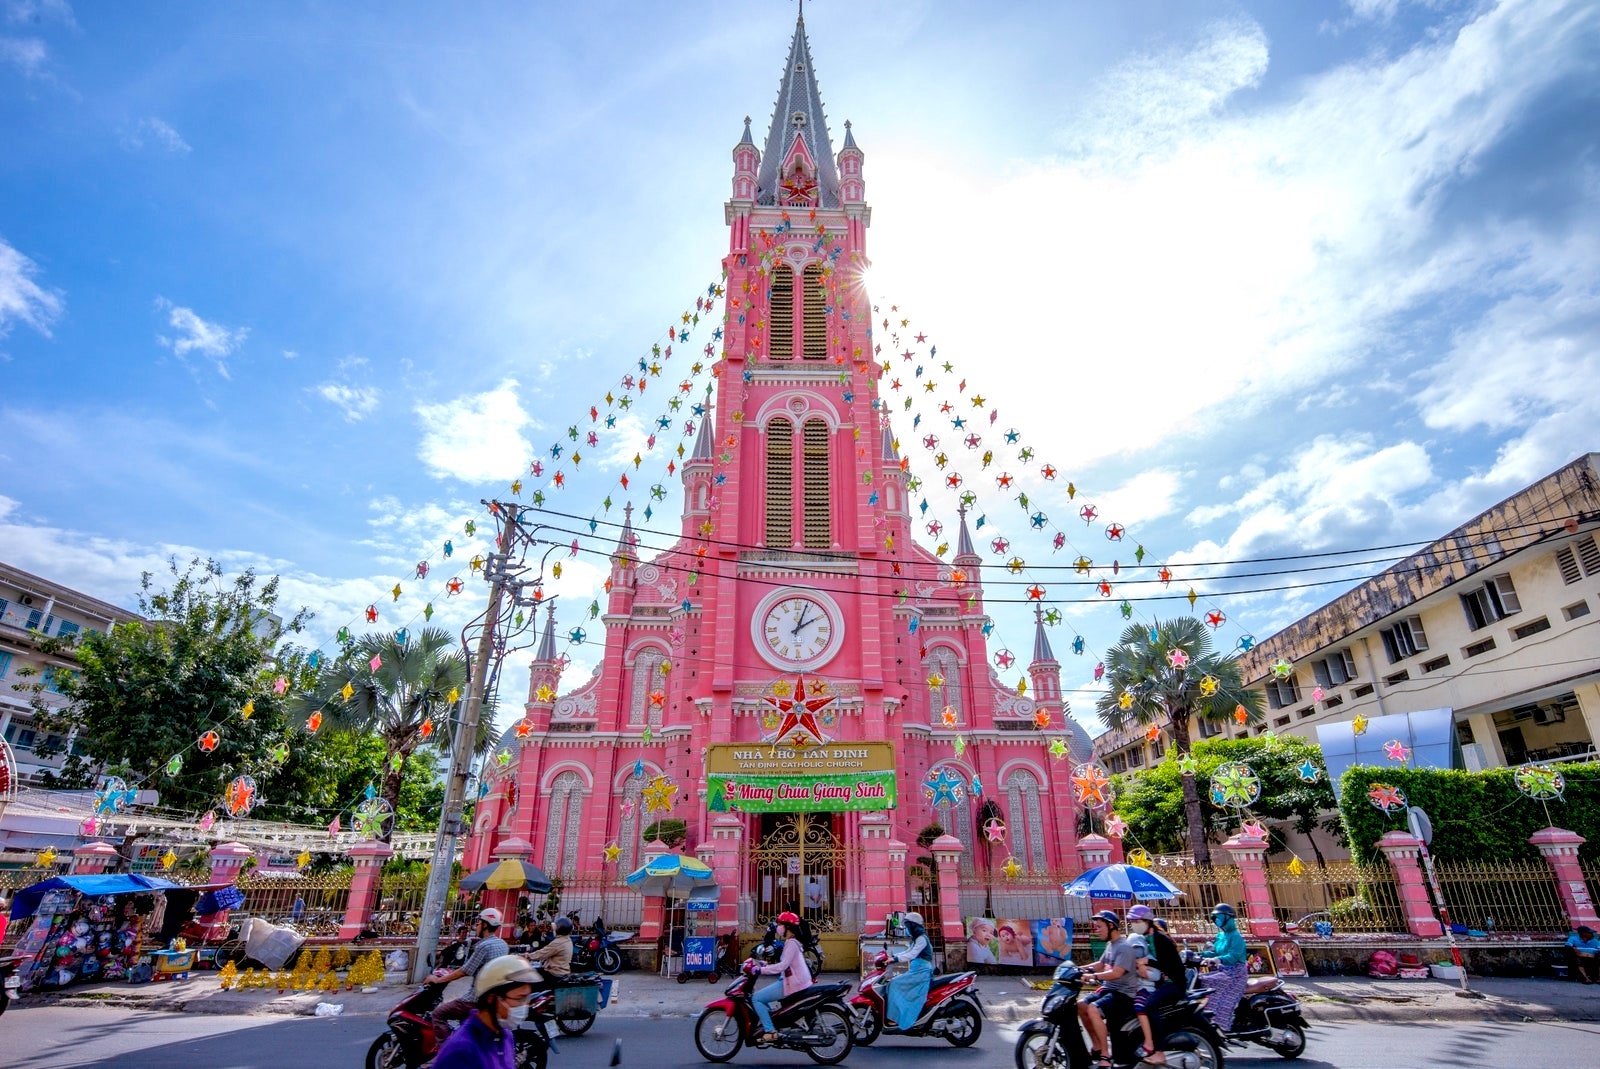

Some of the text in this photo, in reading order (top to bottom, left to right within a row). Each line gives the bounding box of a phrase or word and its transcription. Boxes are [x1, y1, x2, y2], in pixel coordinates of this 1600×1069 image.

[733, 748, 764, 760] NHÀ
[833, 749, 868, 760] ĐỊNH
[777, 781, 810, 799] Chúa
[813, 781, 852, 803] Giáng
[855, 781, 886, 798] Sinh
